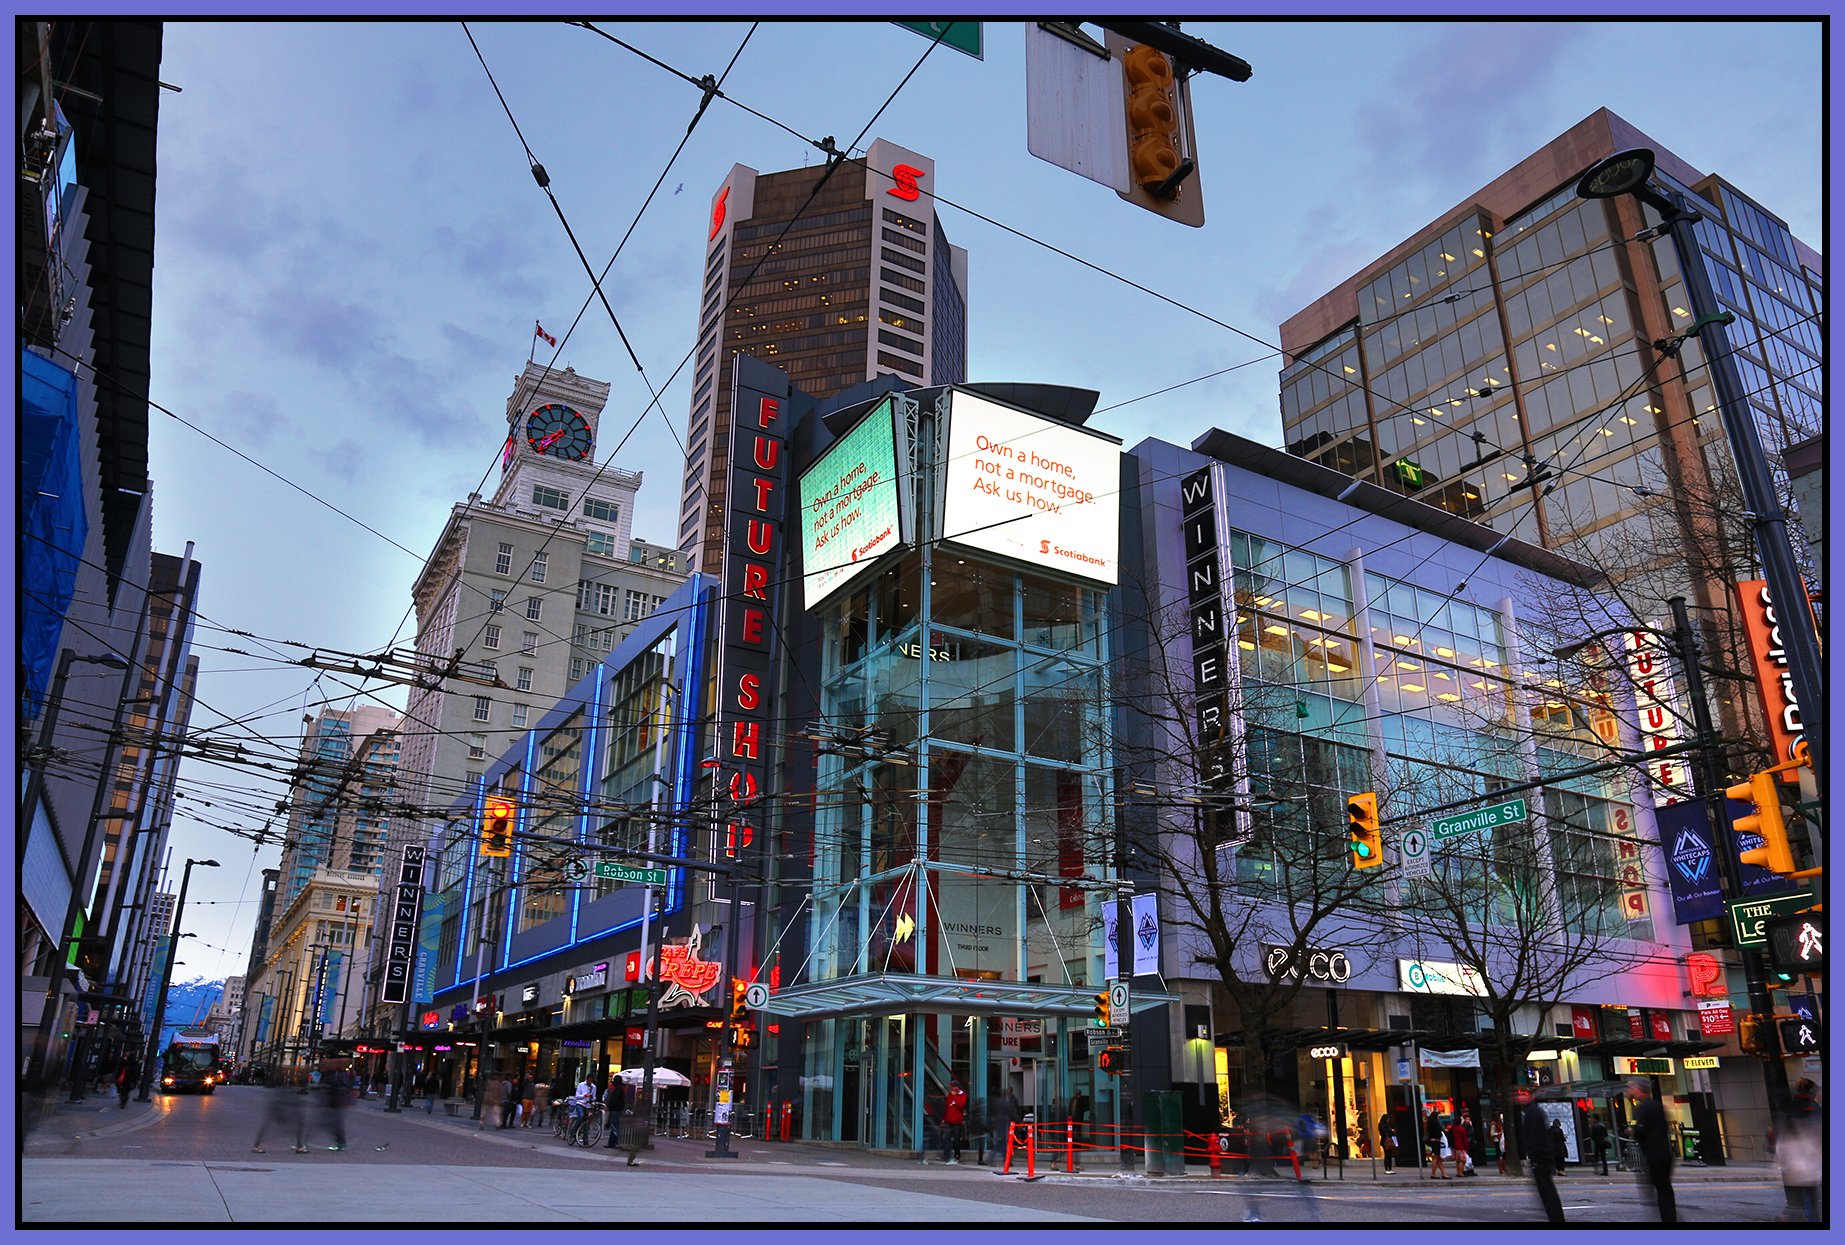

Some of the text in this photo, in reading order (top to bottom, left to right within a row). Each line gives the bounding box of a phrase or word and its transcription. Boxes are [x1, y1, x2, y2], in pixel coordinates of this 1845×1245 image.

[976, 435, 1076, 480] Own a home,
[813, 462, 867, 513] Own a home,
[973, 477, 1062, 515] Ask us how.
[975, 458, 1097, 505] not a mortgage.
[813, 471, 881, 532] not a mortgage.
[815, 507, 862, 552] Ask us how.
[859, 527, 892, 556] Scotiabank
[1053, 545, 1106, 567] Scotiabank
[726, 397, 779, 858] FUTURE SHOP
[1438, 804, 1520, 835] Granville St
[1405, 862, 1428, 870] AUTHORIZED
[1406, 857, 1424, 865] EXCEPT
[1672, 850, 1711, 863] WHITECAPS
[603, 865, 657, 882] Robson St
[393, 850, 423, 978] WINNERS
[1743, 904, 1773, 918] THE
[943, 922, 1002, 935] WINNERS
[415, 952, 428, 999] GRANVILLE
[1310, 1046, 1339, 1059] ecco
